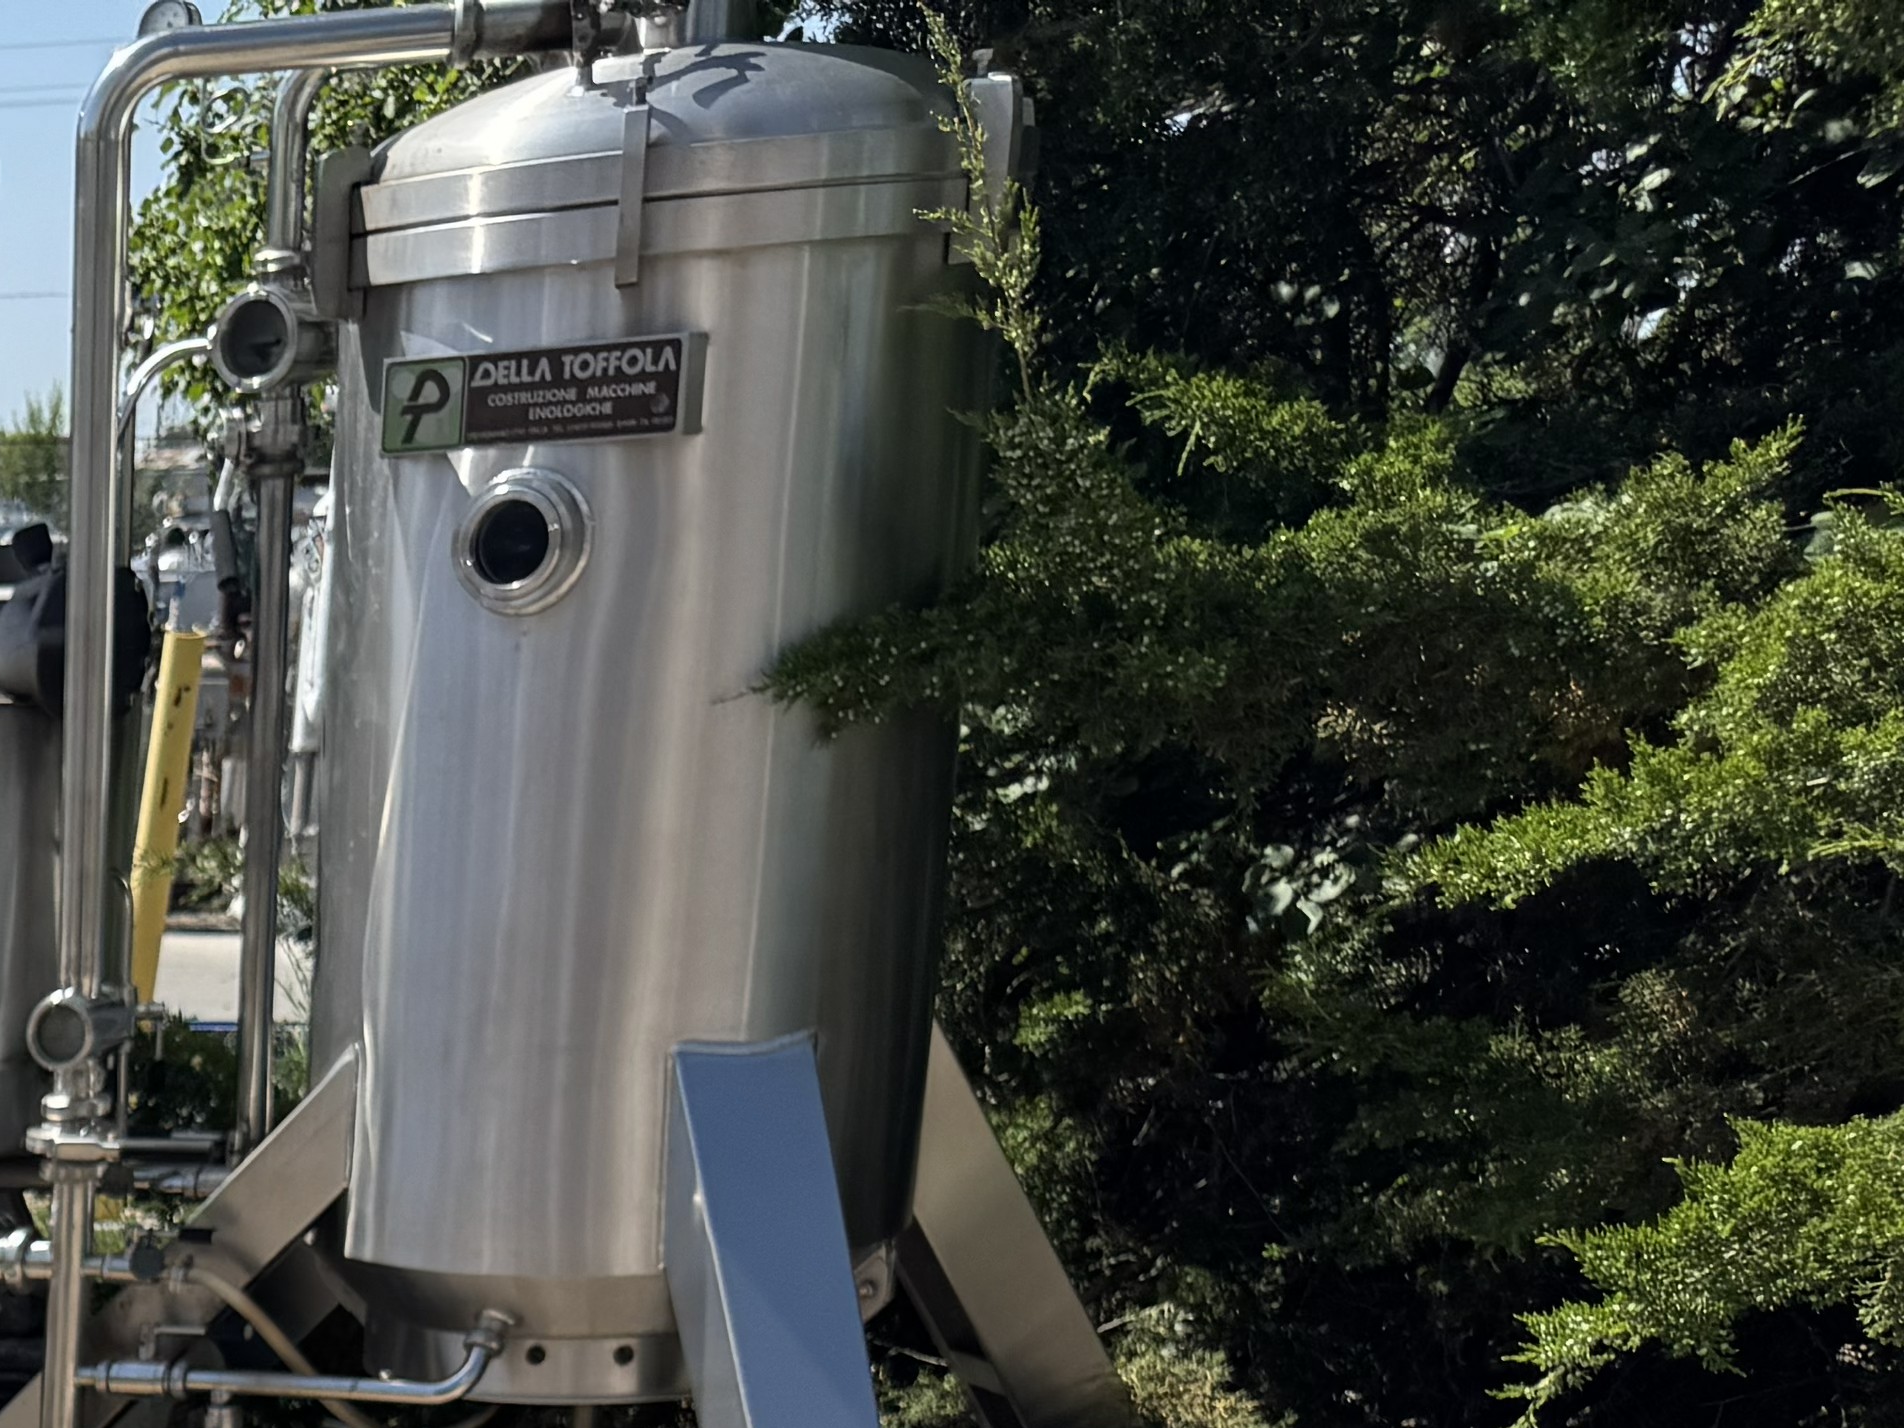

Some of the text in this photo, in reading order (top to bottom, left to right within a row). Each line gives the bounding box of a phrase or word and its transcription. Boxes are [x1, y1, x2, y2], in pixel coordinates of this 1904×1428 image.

[470, 346, 677, 387] DELLA TOFFOLA
[487, 381, 656, 407] COSTRUZIONE MACCHINE
